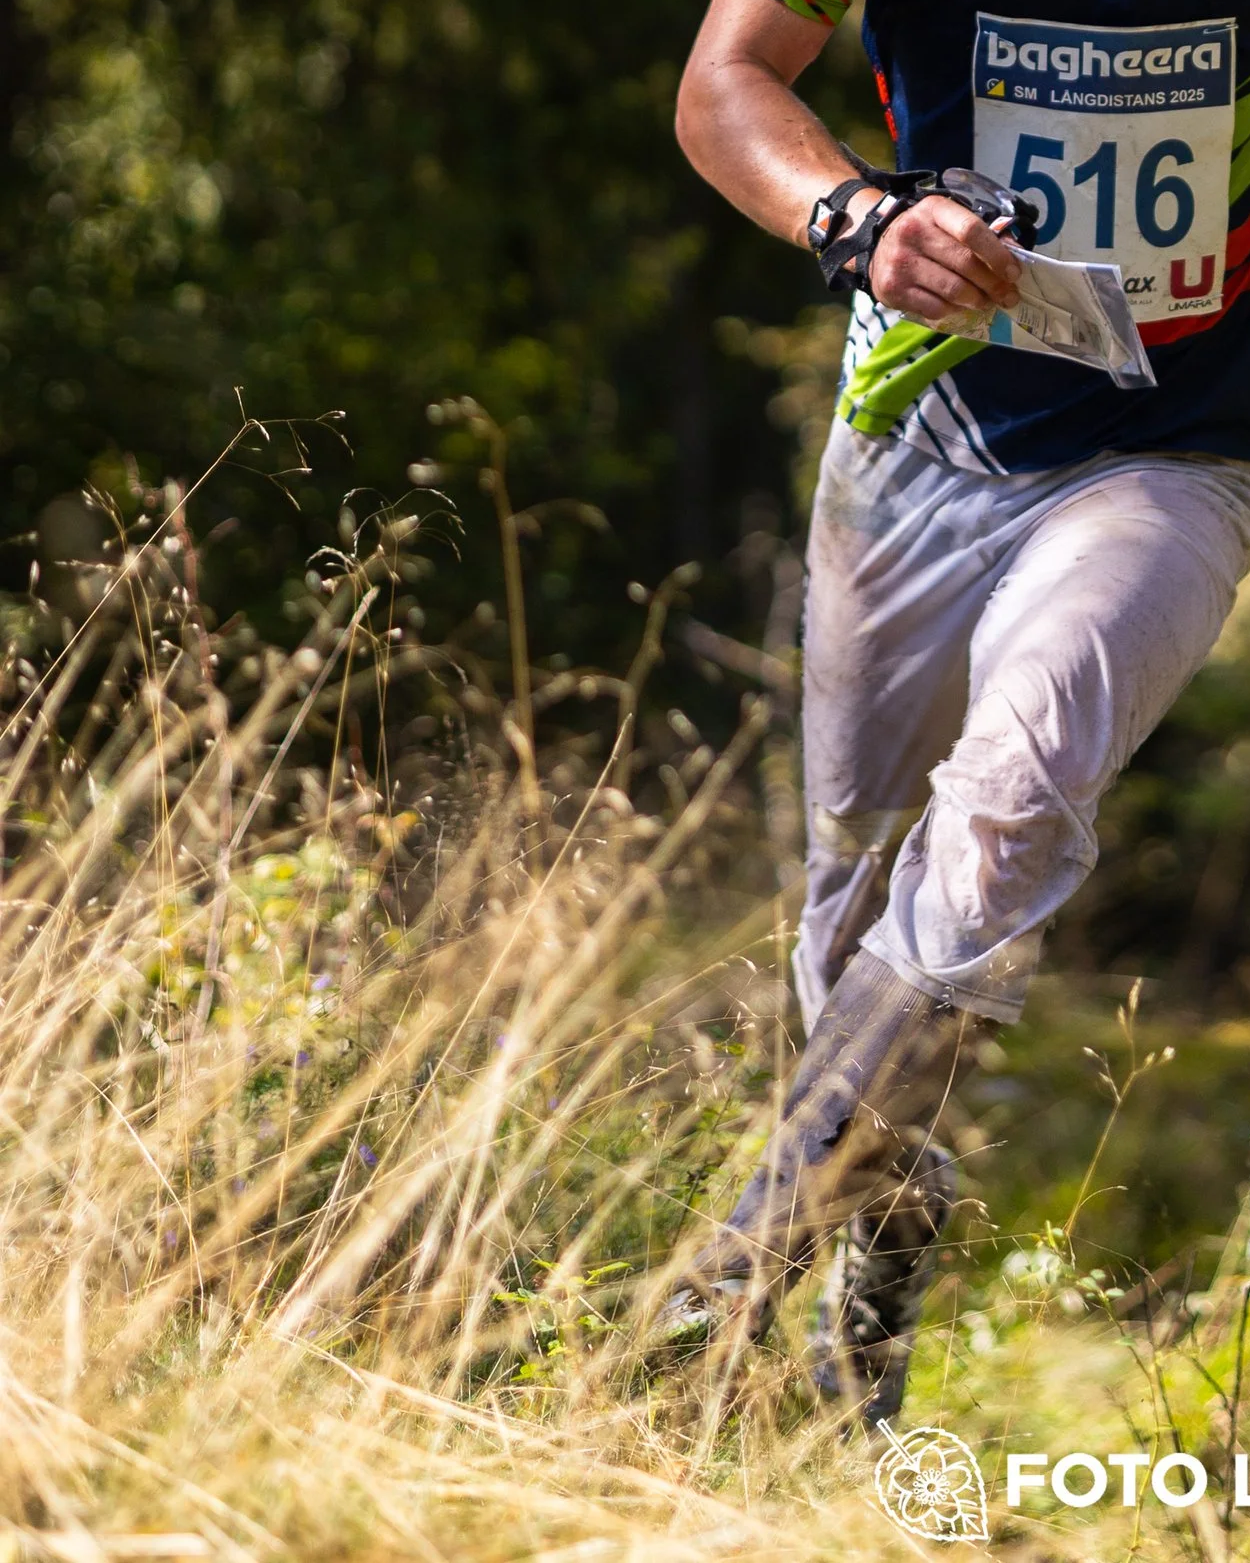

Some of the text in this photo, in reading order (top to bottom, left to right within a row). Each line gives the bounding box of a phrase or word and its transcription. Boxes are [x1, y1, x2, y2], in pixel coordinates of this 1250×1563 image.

[986, 31, 1222, 81] bagheera
[1014, 85, 1206, 107] SM LÅNGDISTANS 2025
[1009, 133, 1196, 250] 516
[1123, 276, 1156, 294] ax
